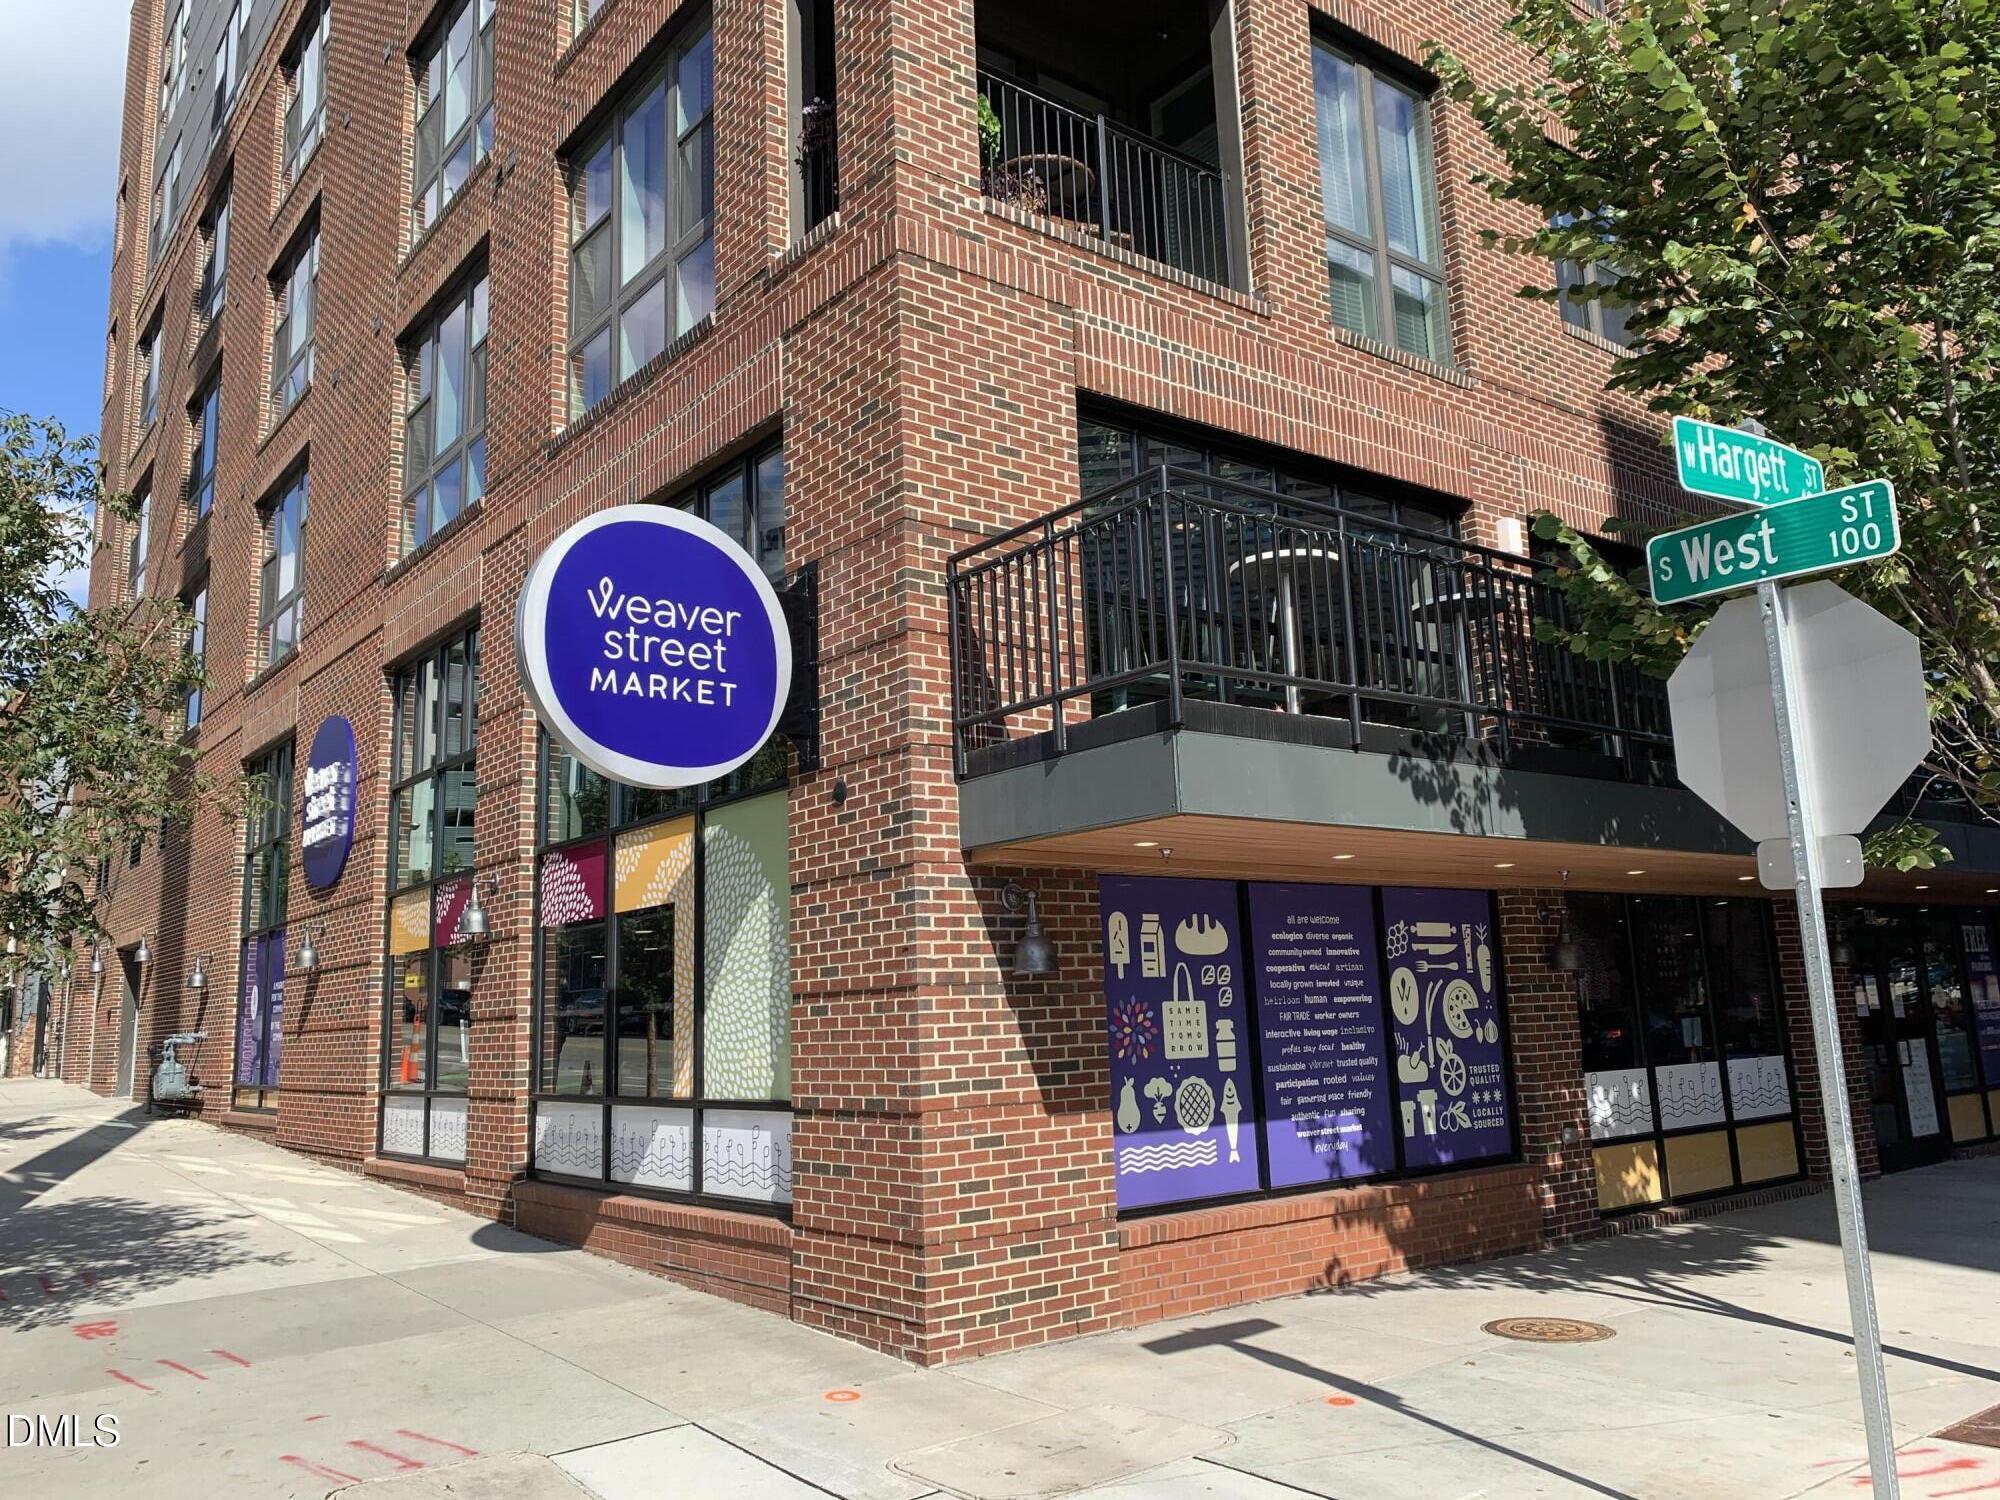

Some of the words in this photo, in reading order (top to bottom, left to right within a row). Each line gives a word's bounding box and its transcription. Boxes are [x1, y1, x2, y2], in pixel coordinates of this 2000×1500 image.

[1683, 440, 1695, 468] W
[1697, 425, 1789, 500] Hargett
[1803, 462, 1818, 490] ST
[1841, 490, 1875, 522] ST
[1659, 556, 1673, 582] S
[1680, 518, 1778, 583] West
[1828, 522, 1881, 557] 100
[587, 576, 741, 636] Weaver
[603, 626, 727, 673] street
[589, 667, 737, 707] MARKET
[1287, 915, 1296, 924] all
[1297, 916, 1309, 924] are
[1310, 916, 1340, 924] welcome
[1305, 932, 1330, 940] diverse
[1331, 932, 1354, 940] organic
[1326, 947, 1360, 956] innovative
[1335, 962, 1364, 971] artisan
[1269, 980, 1292, 990] locally
[1293, 982, 1314, 990] grown
[1304, 994, 1328, 1004] human
[1279, 1012, 1292, 1021] FAIR
[1293, 1011, 1311, 1020] TRADE
[1314, 1011, 1336, 1020] worker
[1338, 1011, 1360, 1019] owners
[1170, 1019, 1201, 1027] TIME
[1265, 1029, 1302, 1039] interactive
[1303, 1029, 1321, 1037] living
[1171, 1044, 1203, 1052] RROW
[1341, 1041, 1366, 1052] healthy
[1267, 1061, 1306, 1073] sustainable
[1336, 1058, 1358, 1067] trusted
[1358, 1056, 1379, 1067] quality
[1469, 1064, 1500, 1074] TRUSTED
[1275, 1077, 1319, 1091] participation
[1323, 1074, 1347, 1085] rooted
[1470, 1074, 1501, 1087] QUALITY
[1280, 1096, 1293, 1106] fair
[1348, 1088, 1372, 1100] friendly
[1291, 1109, 1321, 1122] authentic
[1340, 1106, 1366, 1117] sharing
[1472, 1106, 1504, 1118] LOCALLY
[1473, 1117, 1505, 1129] SOURCED
